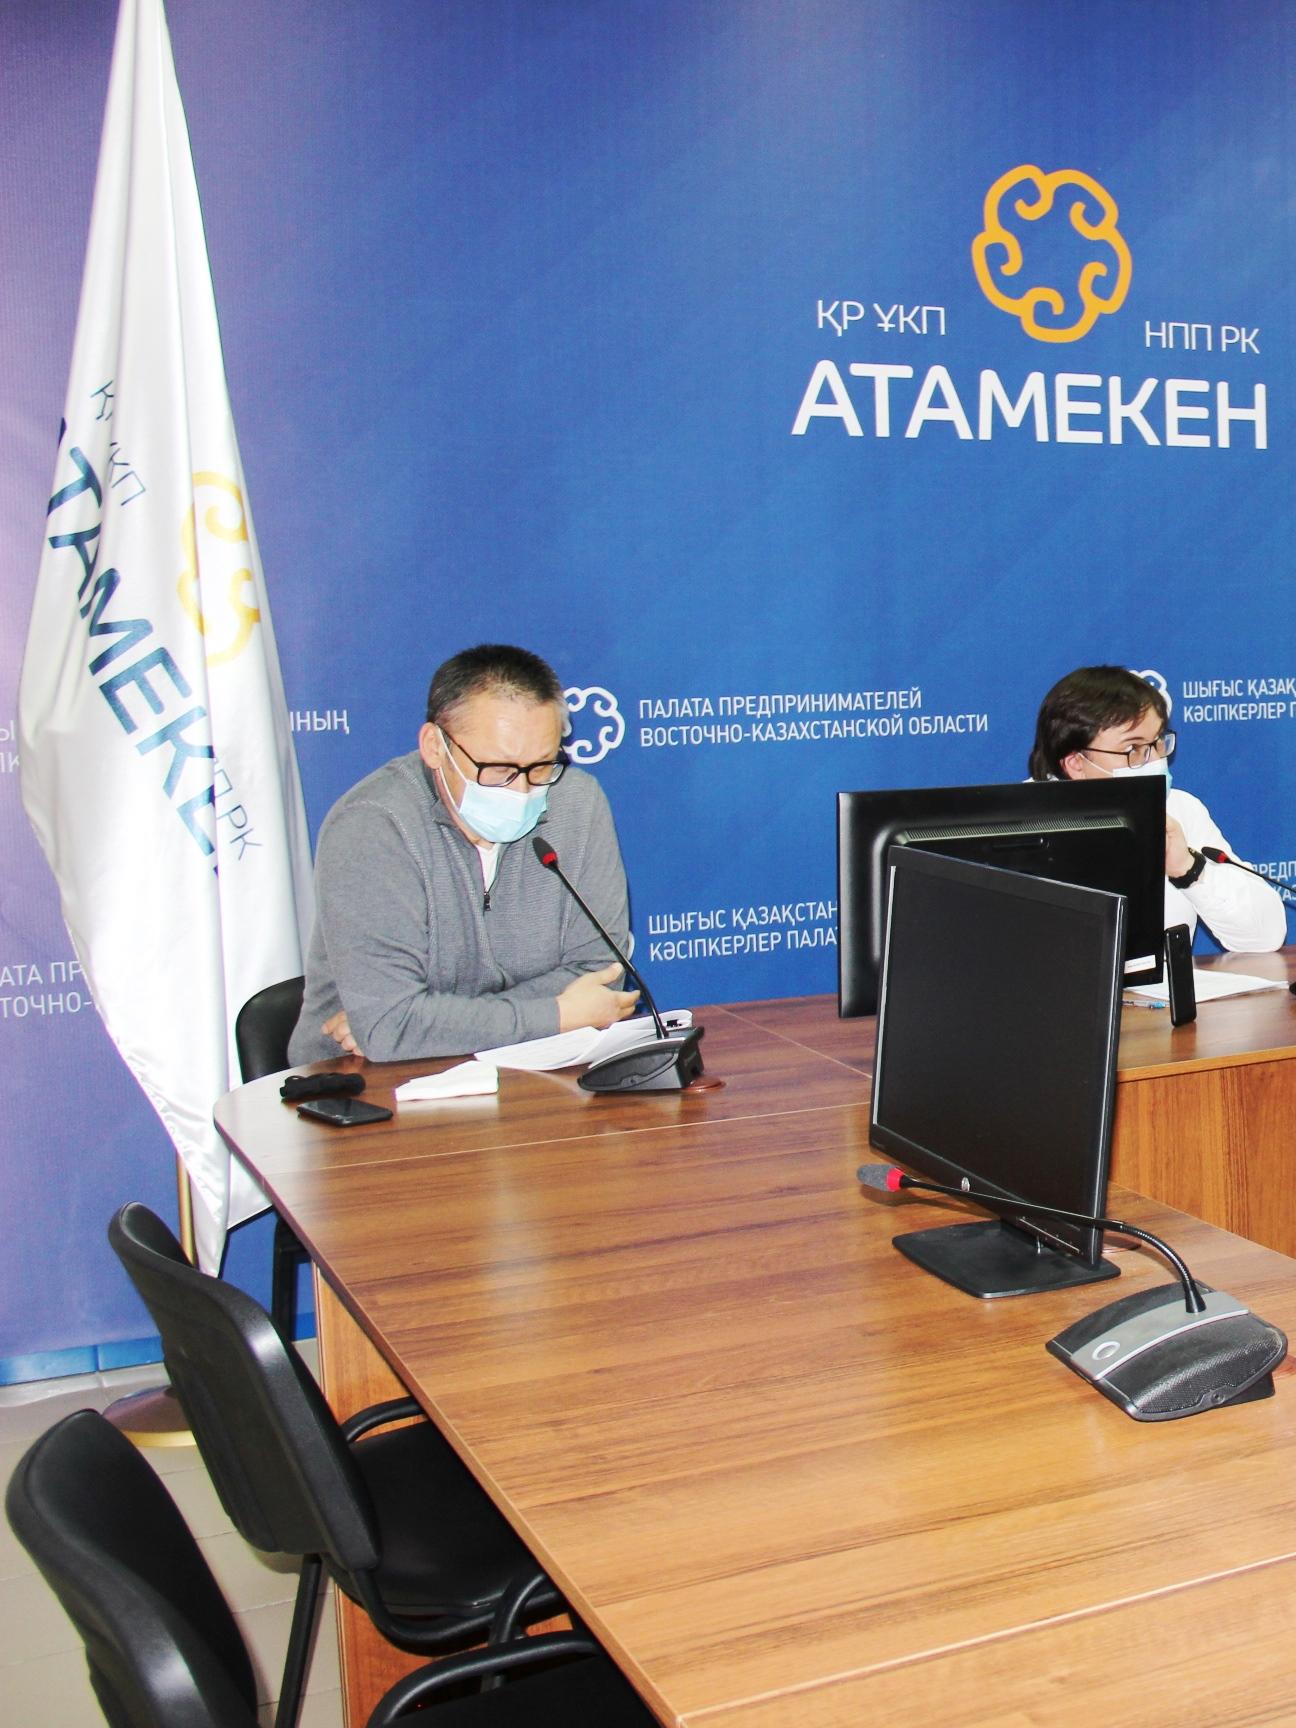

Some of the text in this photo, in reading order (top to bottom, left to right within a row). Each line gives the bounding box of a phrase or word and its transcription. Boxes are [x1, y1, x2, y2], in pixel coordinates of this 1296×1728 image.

[816, 298, 946, 336] ҚР ҰКП
[1144, 320, 1261, 354] НПП РК
[791, 358, 1268, 450] АТАМЕКЕН
[639, 686, 922, 719] ПАЛАТА ПРЕДПРИНИМАТЕЛЕЙ
[1182, 679, 1244, 699] ШЫҒЫС
[1183, 701, 1286, 723] КӘСІПКЕРЛЕР
[640, 713, 990, 747] ВОСТОЧНО-КАЗАХСТАНСКОЙ ОБЛАСТИ
[648, 909, 727, 935] ШЫҒЫС
[650, 925, 838, 962] КӘСІПКЕРЛЕР ПАЛА
